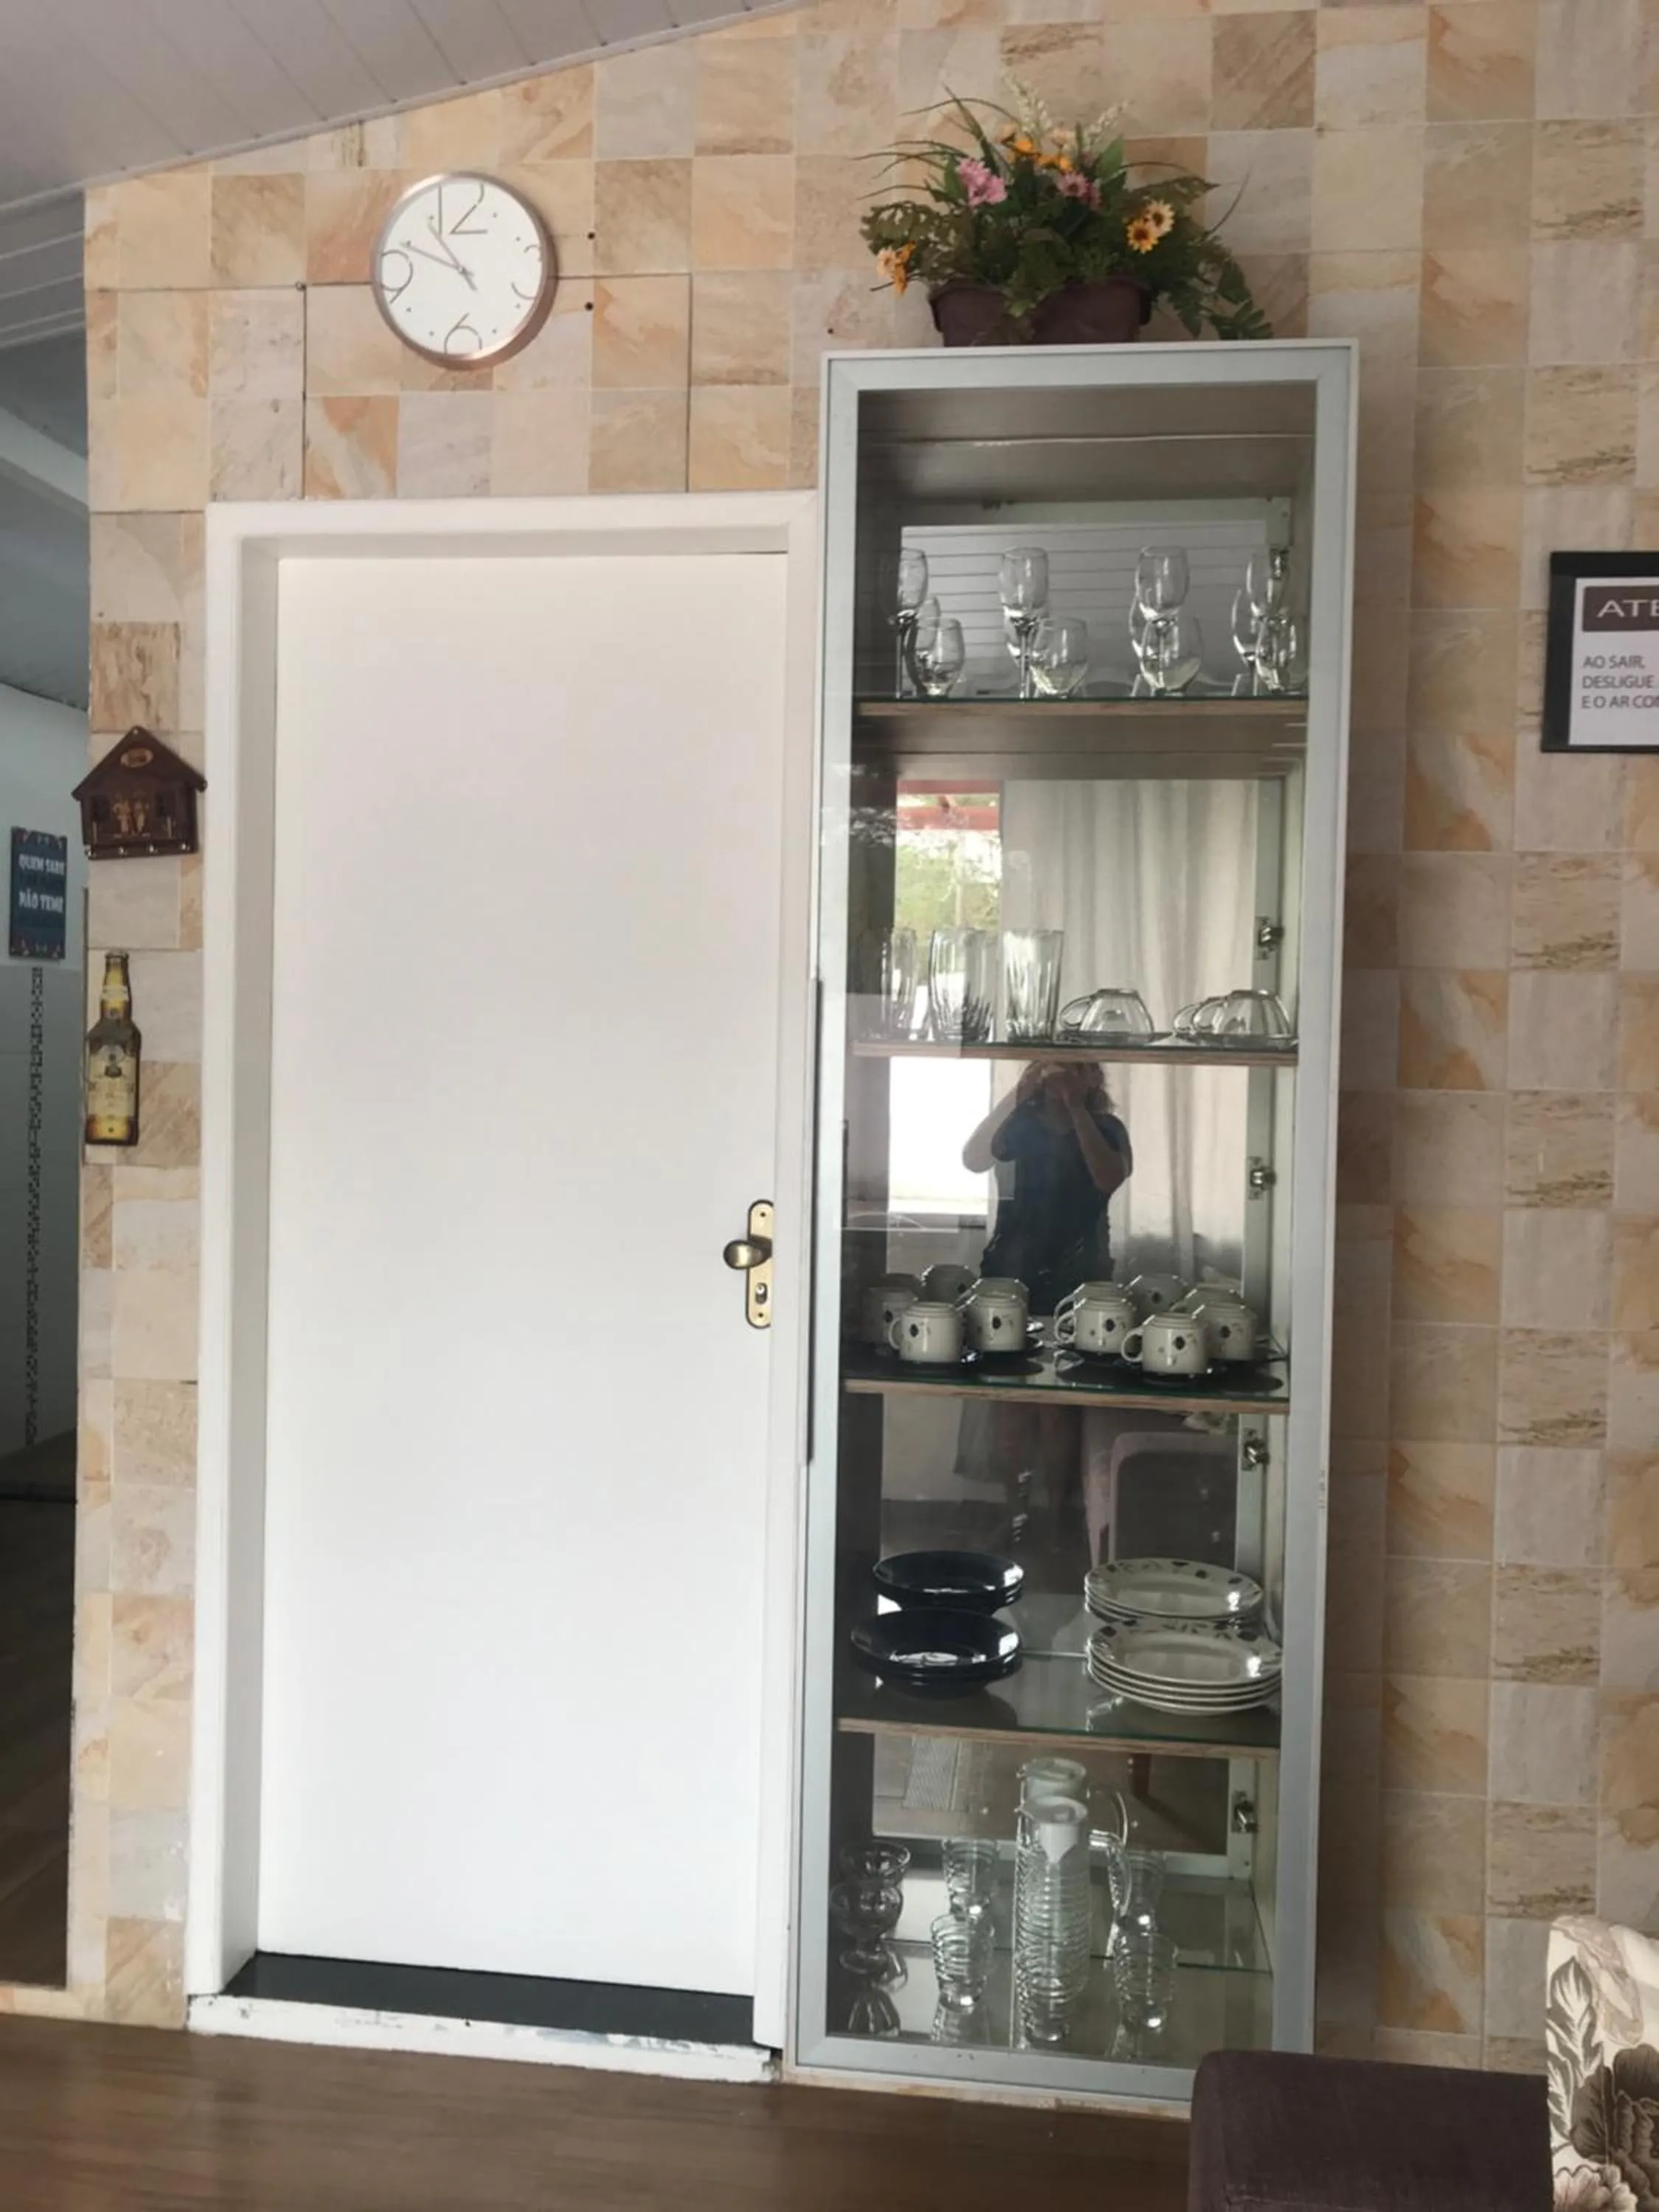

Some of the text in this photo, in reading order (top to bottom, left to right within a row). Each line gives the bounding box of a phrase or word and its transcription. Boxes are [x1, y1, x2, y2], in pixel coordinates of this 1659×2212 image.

[1582, 655, 1606, 669] AO
[1582, 675, 1655, 689] DESLIGUE
[1582, 695, 1591, 709] E
[1593, 695, 1607, 709] O
[1609, 695, 1629, 709] AR
